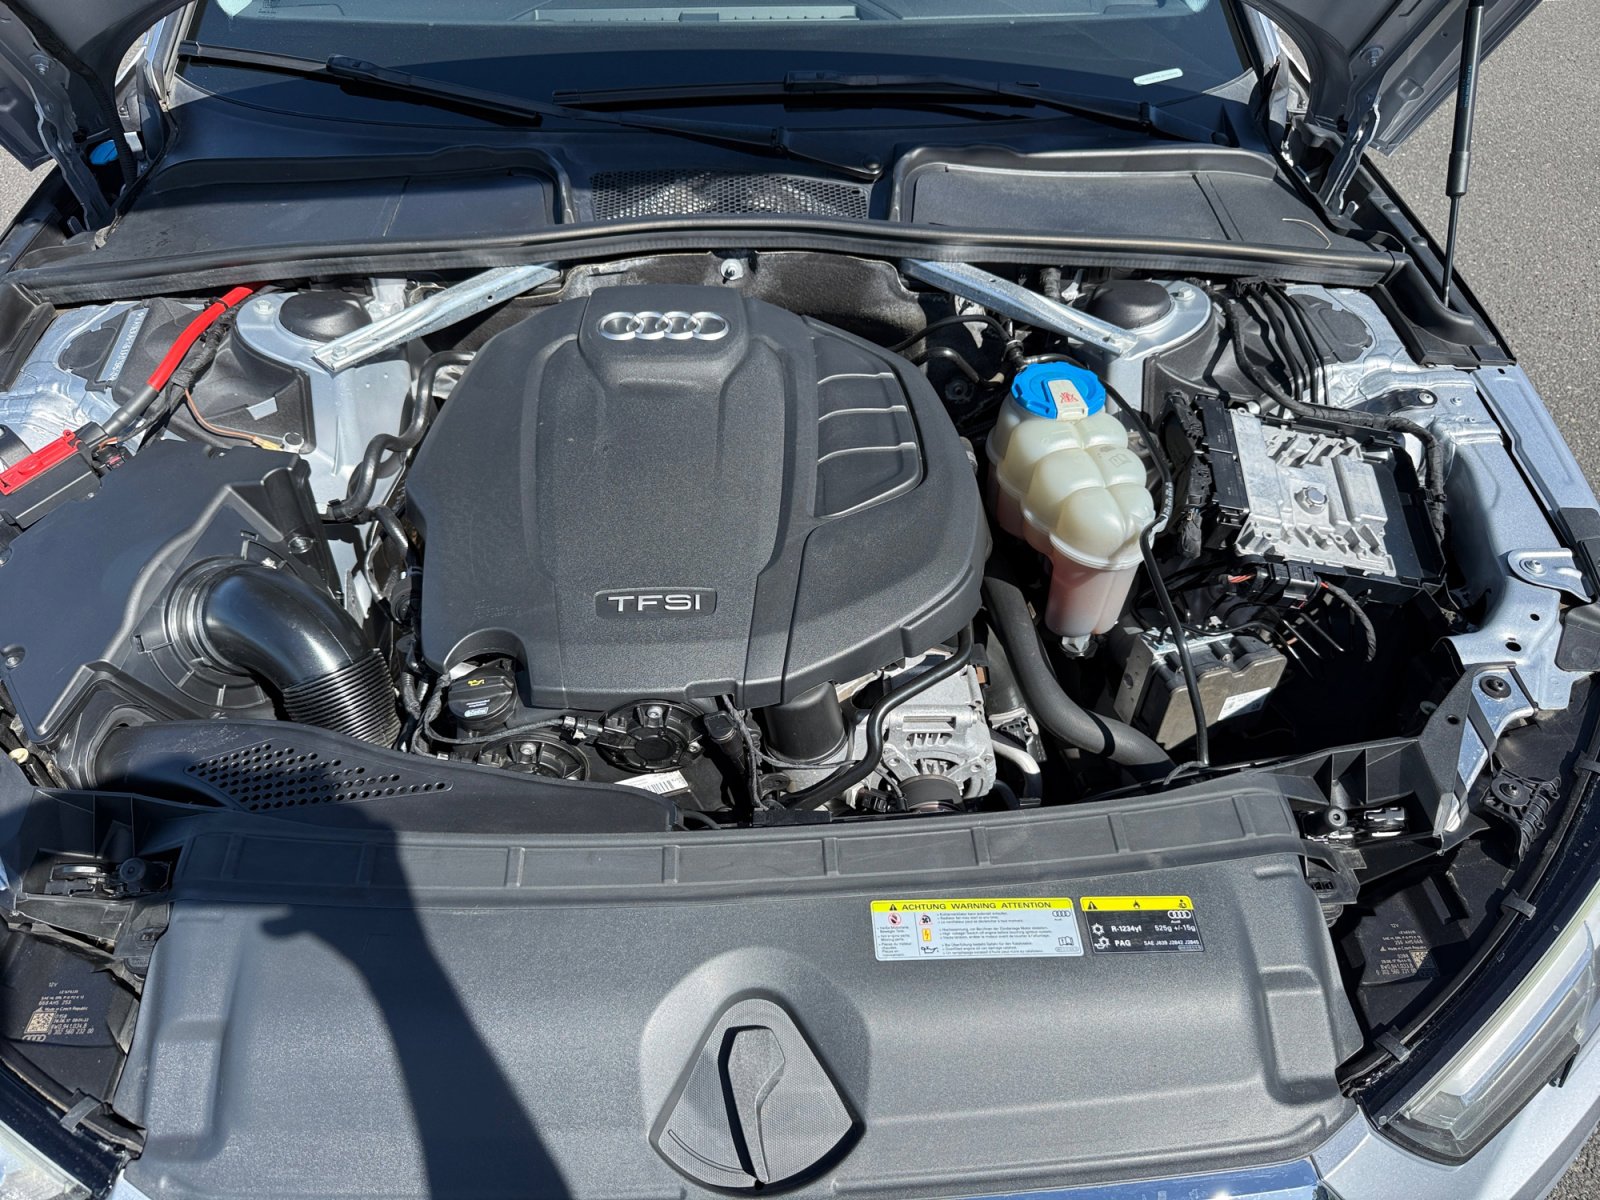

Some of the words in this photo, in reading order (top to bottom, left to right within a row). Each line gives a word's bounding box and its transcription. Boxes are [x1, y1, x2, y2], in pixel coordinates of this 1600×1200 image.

[607, 594, 701, 612] TFSI
[1111, 925, 1142, 933] R-1234yf
[1154, 924, 1172, 933] 525g
